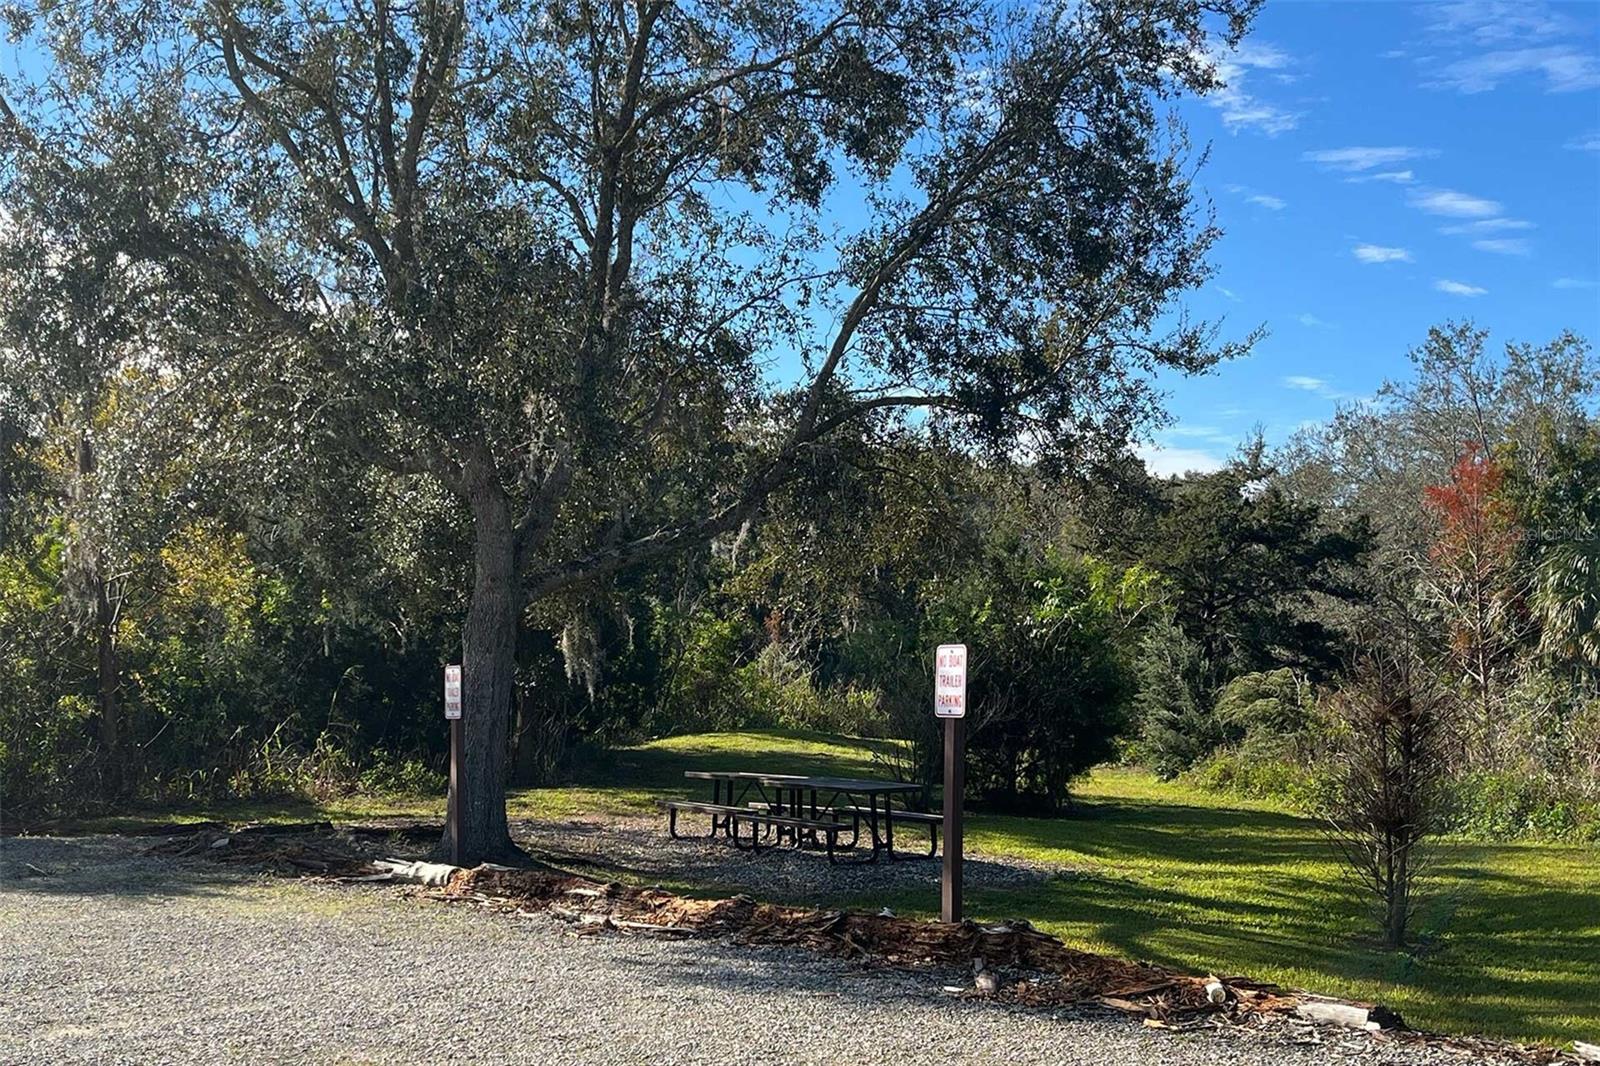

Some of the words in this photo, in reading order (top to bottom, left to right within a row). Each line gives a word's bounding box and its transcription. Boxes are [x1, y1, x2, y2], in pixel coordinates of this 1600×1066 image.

[938, 655, 947, 667] NO
[949, 655, 963, 667] BOAT
[939, 675, 962, 688] TRAILER
[938, 694, 962, 707] PARKING
